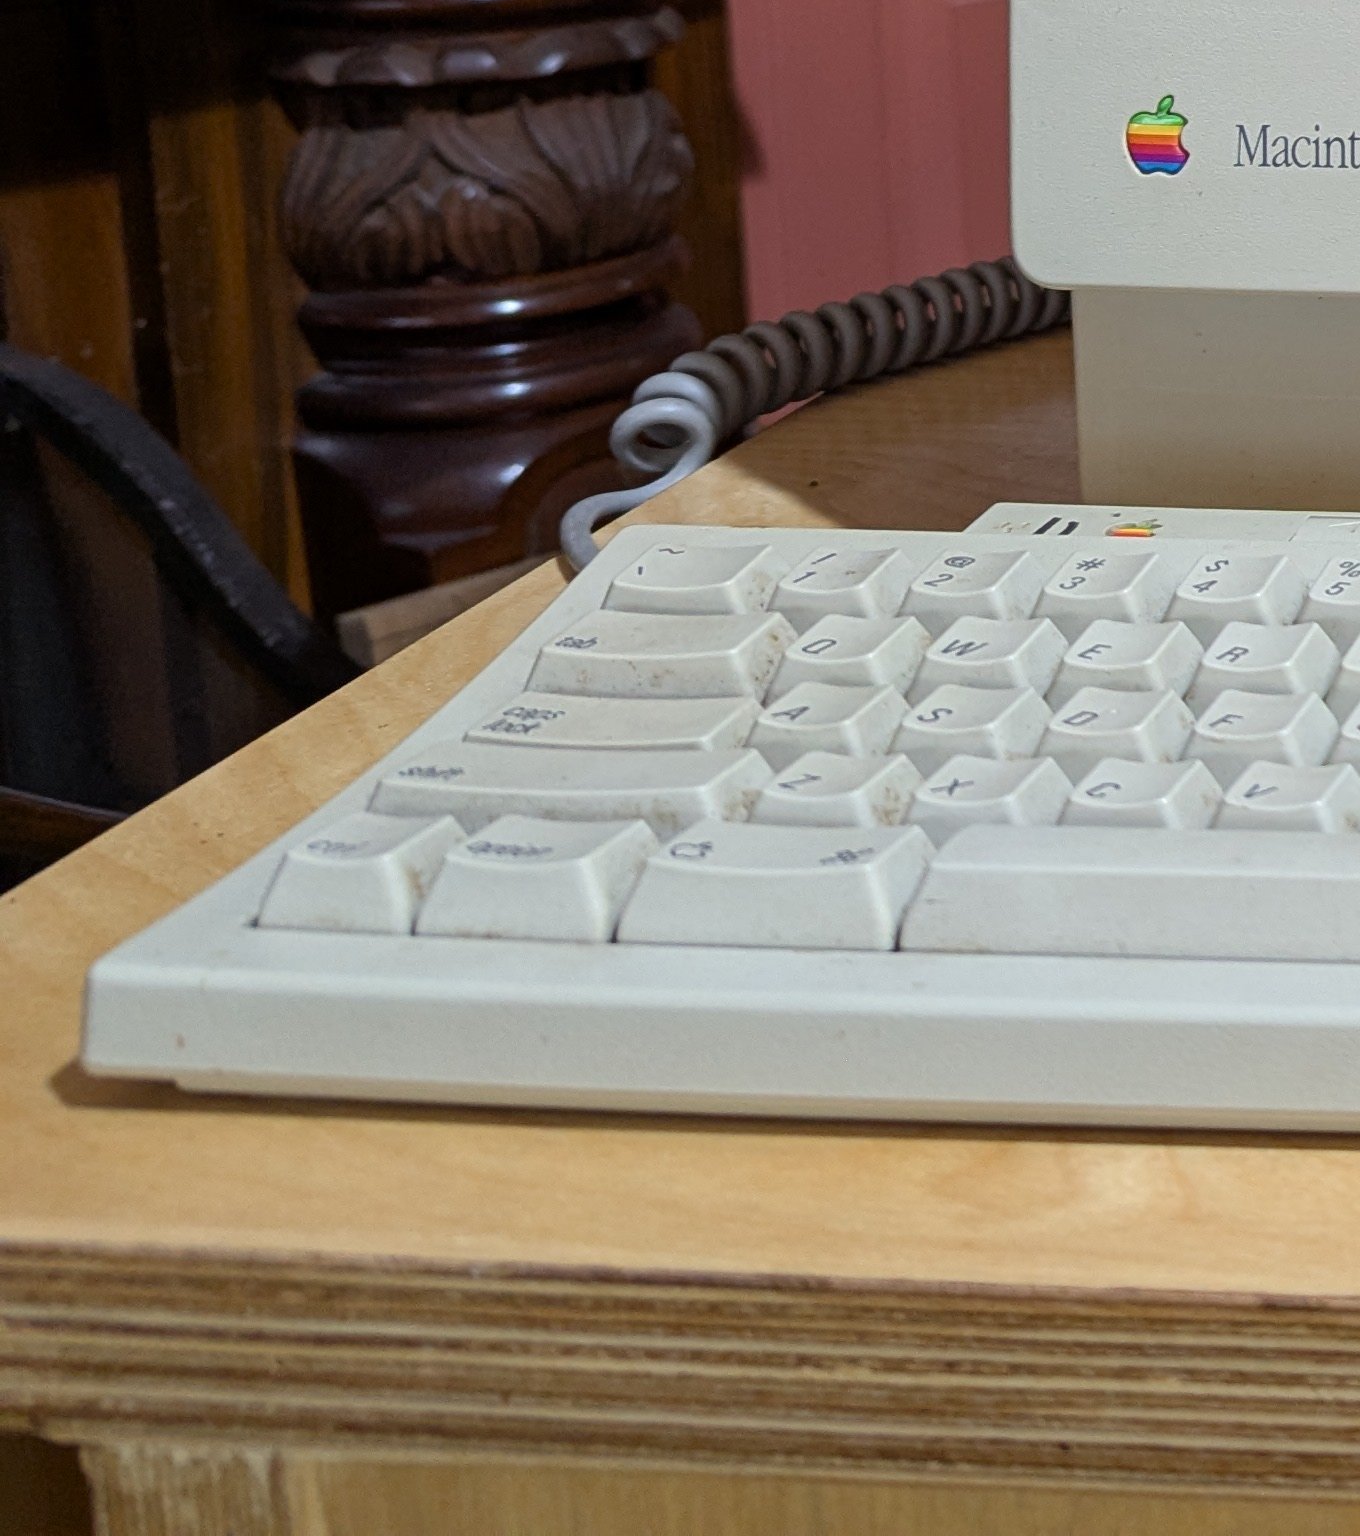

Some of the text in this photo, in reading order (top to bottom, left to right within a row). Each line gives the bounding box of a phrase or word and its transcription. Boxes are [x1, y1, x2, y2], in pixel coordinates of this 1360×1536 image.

[1075, 557, 1107, 572] #
[923, 573, 955, 588] 2
[1058, 576, 1087, 590] 3
[1192, 579, 1219, 593] 4
[1324, 581, 1347, 596] 5
[937, 636, 989, 657] W
[1077, 643, 1113, 661] E
[1215, 646, 1250, 663] R
[767, 703, 811, 722] A
[913, 705, 953, 723] S
[1059, 708, 1101, 727] D
[1208, 713, 1244, 729] F
[775, 770, 822, 791] Z
[927, 776, 975, 797] X
[1085, 782, 1122, 799] C
[1243, 783, 1279, 799] V
